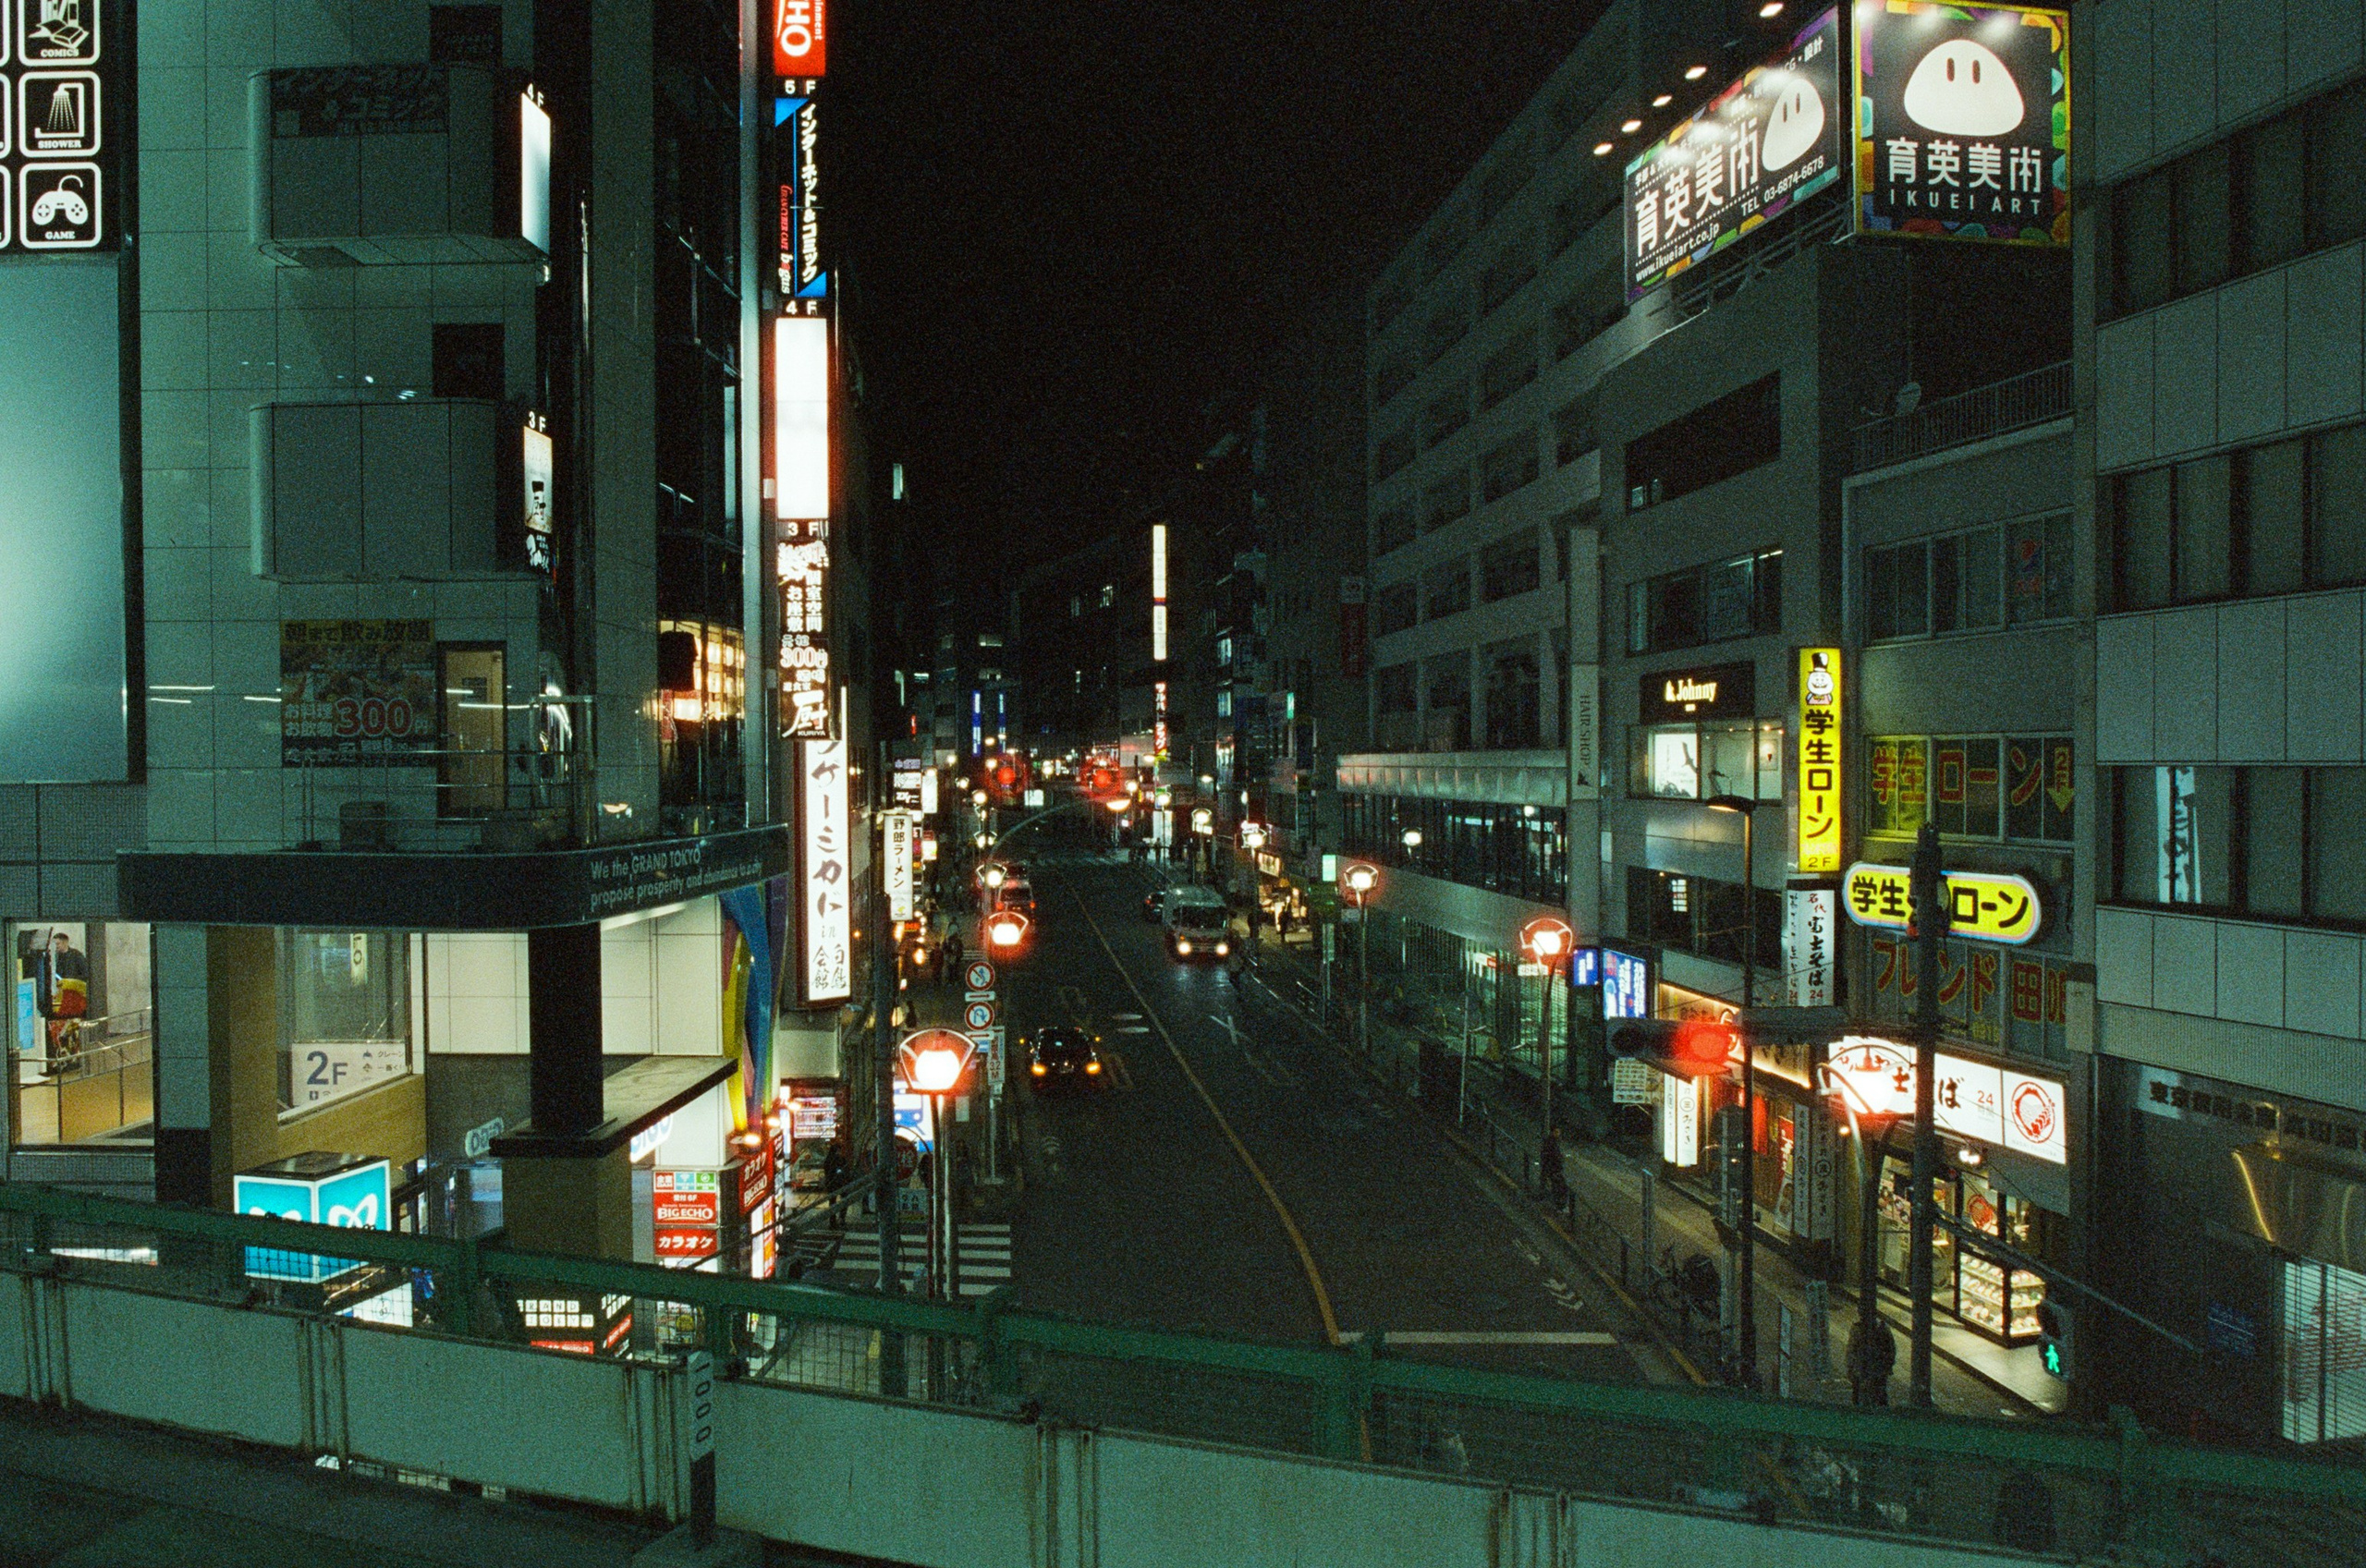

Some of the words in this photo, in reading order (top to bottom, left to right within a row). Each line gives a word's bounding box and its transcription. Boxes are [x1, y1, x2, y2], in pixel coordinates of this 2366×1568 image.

[41, 49, 79, 57] COMICS
[38, 140, 81, 149] SHOWER
[1886, 136, 2041, 193] 育英美術
[1635, 116, 1759, 259] 育英美術
[1741, 201, 1760, 217] TEL
[1764, 154, 1824, 203] 03-6874-6678
[1890, 188, 1974, 211] IKUEI
[1992, 196, 2040, 215] ART
[1635, 223, 1720, 282] www.ikueiart.co.jp
[778, 253, 793, 294] bagus
[1676, 678, 1717, 702] Johnny
[335, 697, 413, 737] 300
[1805, 709, 1835, 838] 学生ローン
[1872, 747, 2042, 807] 学生ローン
[591, 861, 609, 879] We
[613, 857, 628, 875] the
[670, 847, 701, 867] TOKYO
[893, 819, 905, 888] 野郎ラーメン
[1808, 857, 1831, 867] 2F
[591, 886, 635, 912] propose
[822, 925, 835, 938] in
[1809, 990, 1823, 999] 24
[307, 1051, 348, 1086] 2F
[1977, 1089, 1994, 1105] 24
[657, 1207, 680, 1221] BIG
[681, 1208, 713, 1220] ECHO
[659, 1236, 713, 1249] カラオケ
